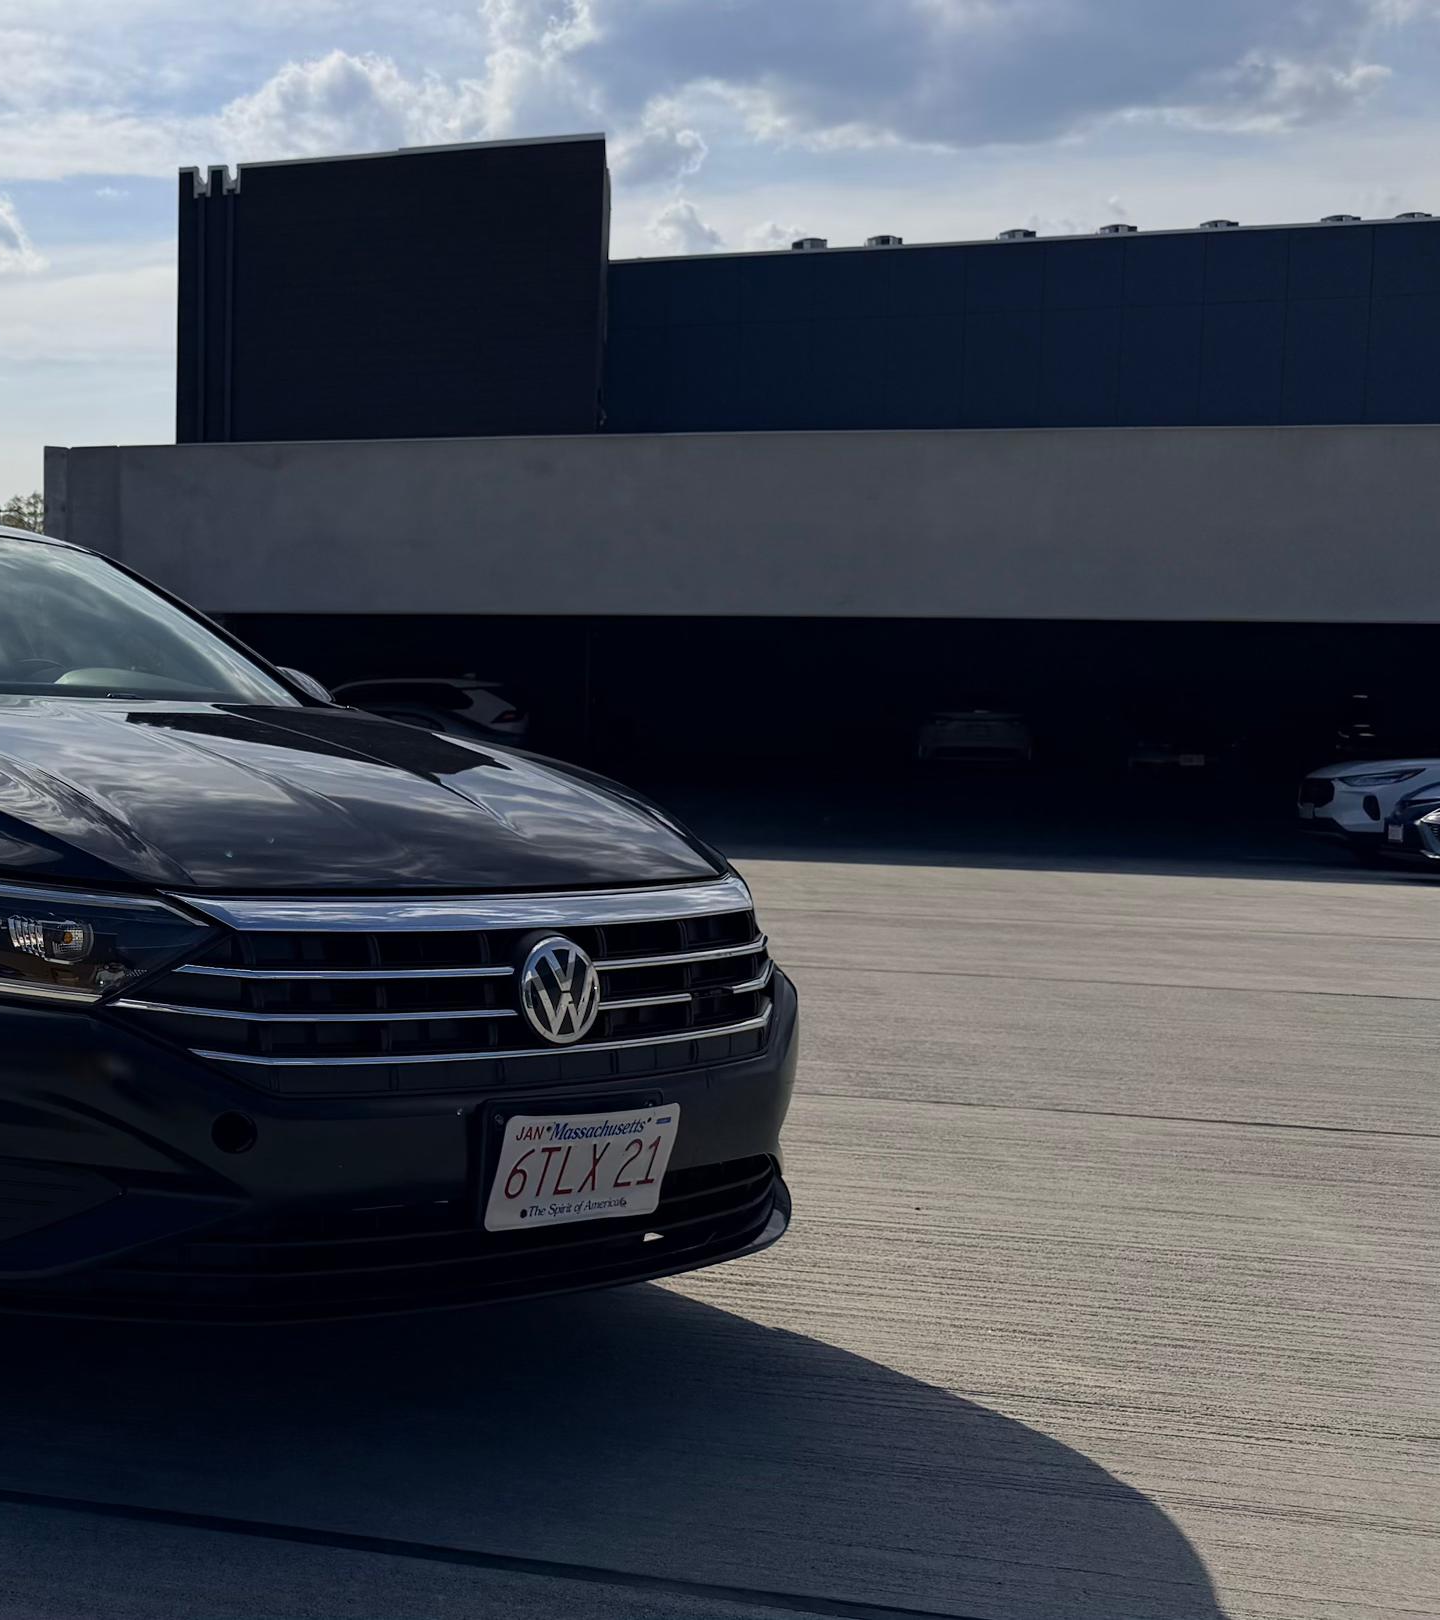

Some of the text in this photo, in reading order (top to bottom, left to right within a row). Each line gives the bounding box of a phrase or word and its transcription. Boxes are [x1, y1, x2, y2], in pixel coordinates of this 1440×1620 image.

[521, 936, 601, 1044] VW
[515, 1119, 646, 1141] JAN Massachusetts
[503, 1135, 662, 1200] 6TLX 21
[529, 1205, 546, 1217] The
[548, 1202, 573, 1217] Spirit
[574, 1200, 585, 1215] of
